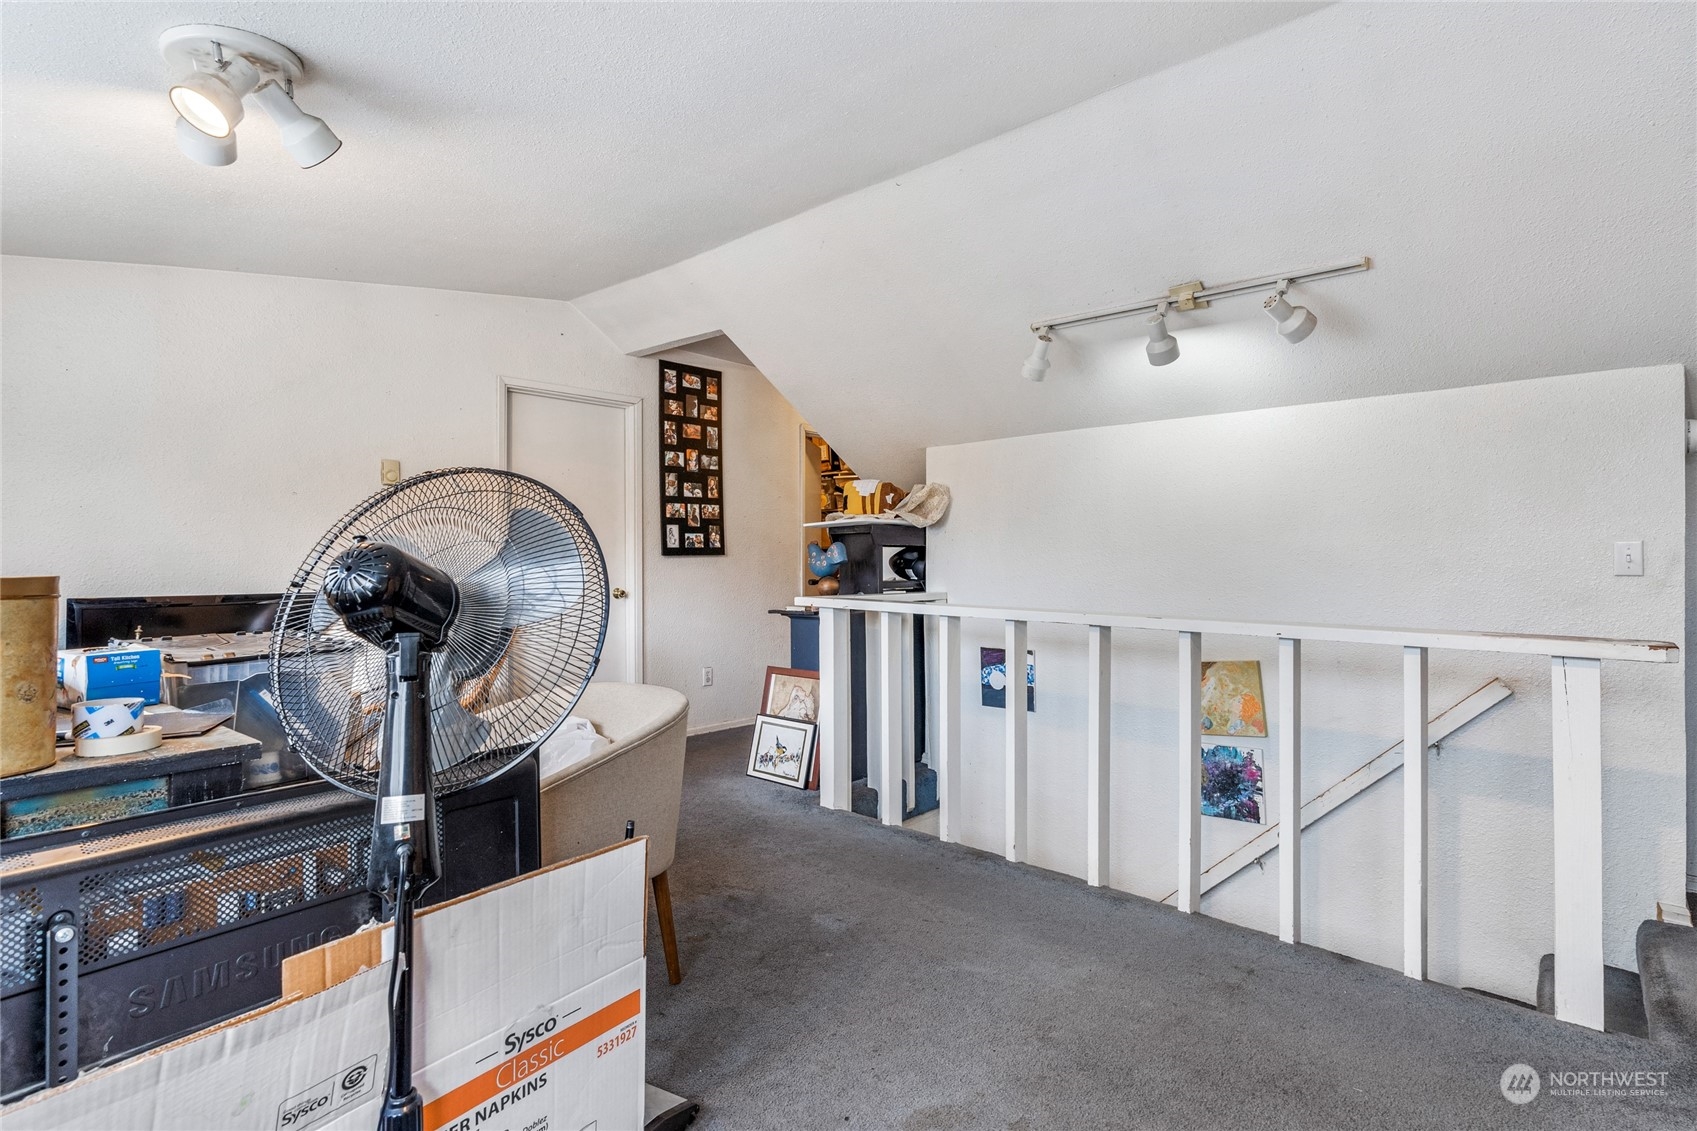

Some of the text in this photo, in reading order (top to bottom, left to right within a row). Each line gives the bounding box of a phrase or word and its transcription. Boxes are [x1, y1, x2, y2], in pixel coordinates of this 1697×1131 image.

[129, 925, 342, 1019] SAMSUNG
[504, 1017, 557, 1055] Sysco
[597, 1025, 637, 1058] 5331927
[496, 1039, 565, 1088] Classic
[281, 1096, 329, 1127] Sysco
[475, 1072, 548, 1126] NAPKINS
